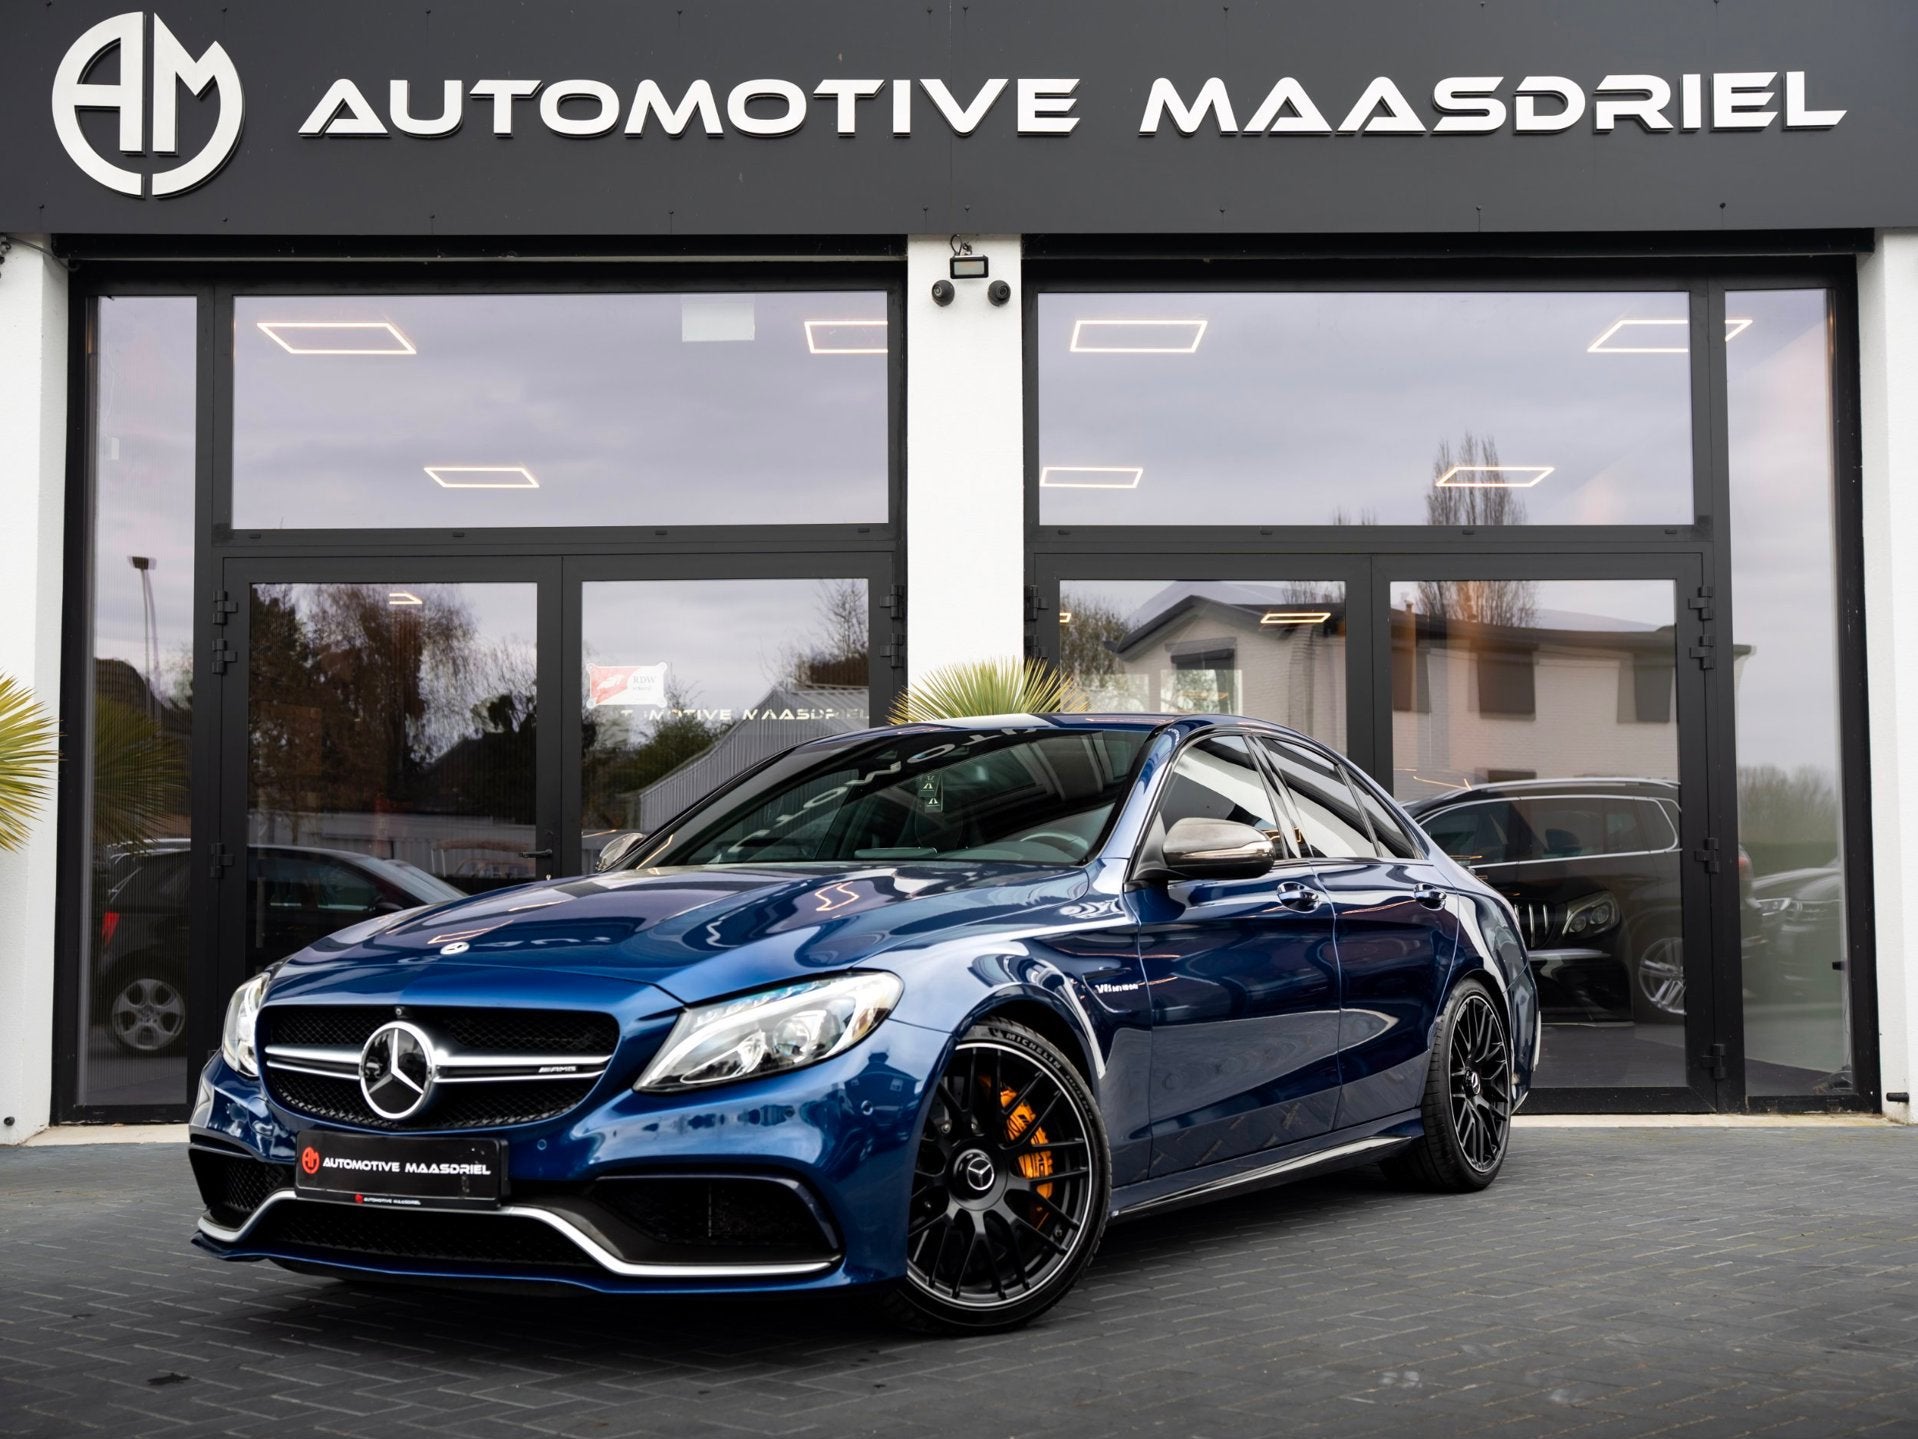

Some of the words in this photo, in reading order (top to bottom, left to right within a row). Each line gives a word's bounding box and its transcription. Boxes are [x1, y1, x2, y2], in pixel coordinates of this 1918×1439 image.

[298, 78, 1081, 137] AUTOMOTIVE
[1139, 71, 1848, 136] MAASDRIEL
[1005, 1032, 1062, 1069] MICHELIN
[323, 1157, 400, 1172] AUTOMOTIVE
[405, 1163, 491, 1175] MAASDRIEL
